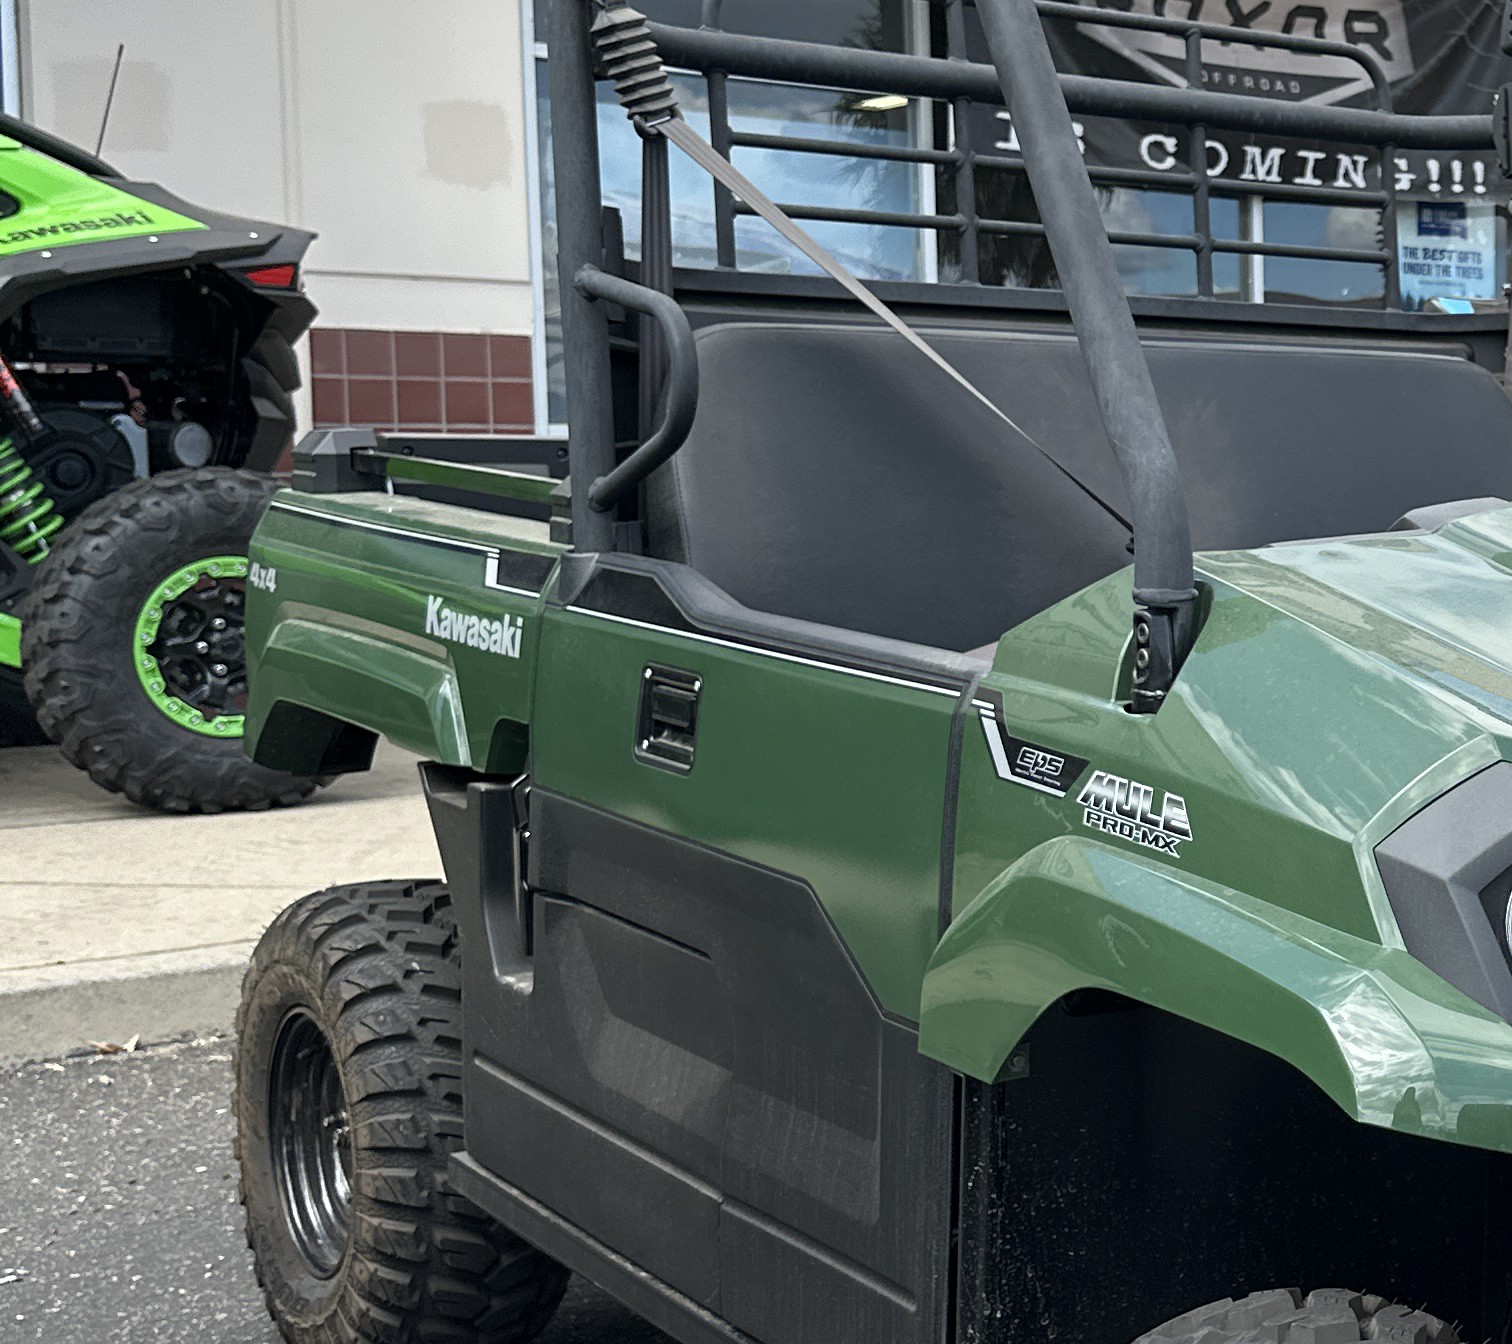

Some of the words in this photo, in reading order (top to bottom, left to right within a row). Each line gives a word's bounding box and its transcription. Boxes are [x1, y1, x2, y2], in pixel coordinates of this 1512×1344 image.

[1200, 69, 1302, 94] OFFROAD
[0, 210, 155, 245] awasaki
[1422, 246, 1454, 262] BEST
[250, 563, 277, 593] 4x4
[425, 594, 524, 658] Kawasaki
[1016, 747, 1065, 777] EPS
[1076, 770, 1193, 841] MULE
